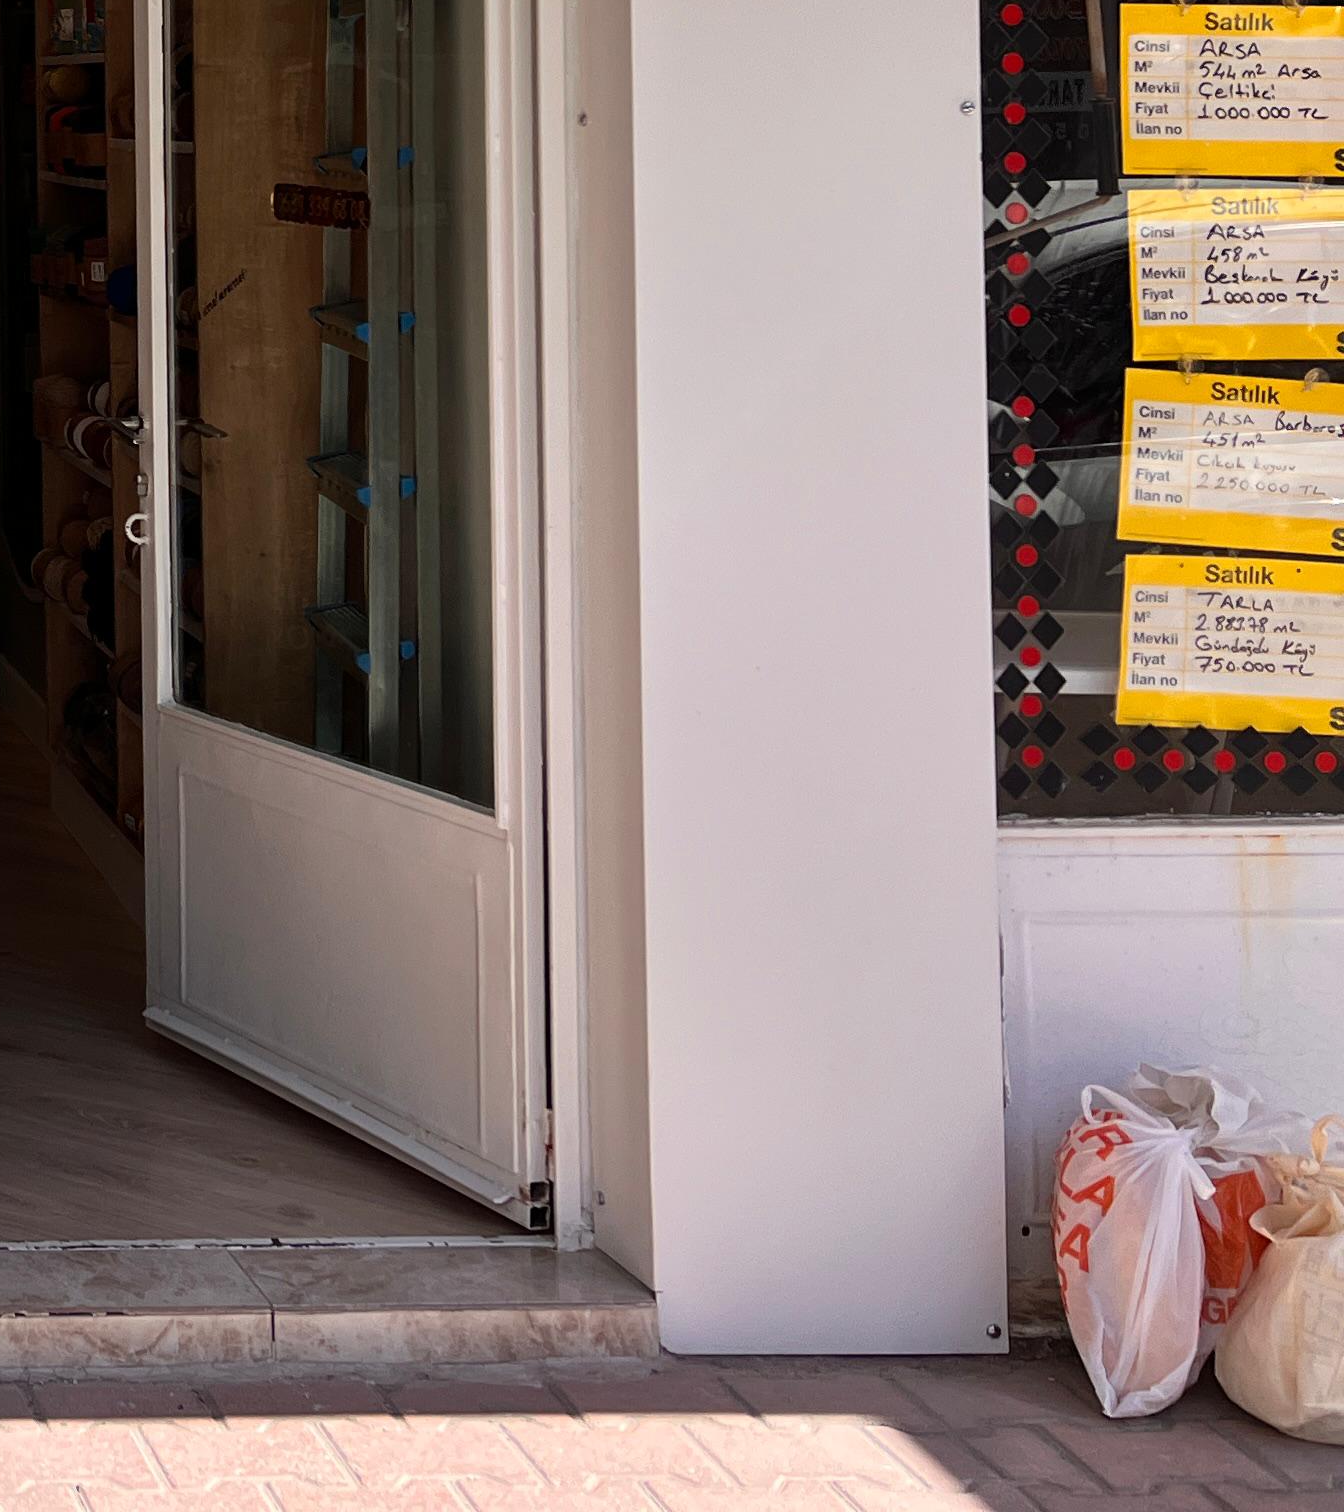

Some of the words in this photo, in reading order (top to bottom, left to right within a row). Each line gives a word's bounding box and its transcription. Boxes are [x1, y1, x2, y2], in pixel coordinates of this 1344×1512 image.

[1204, 12, 1274, 31] Satılık
[1135, 41, 1170, 52] Cinsi
[1199, 39, 1261, 59] ARSA
[1199, 61, 1236, 79] 544
[1135, 82, 1180, 93] Mevkii
[1135, 102, 1168, 116] Fiyat
[1298, 108, 1329, 119] TL
[1136, 121, 1160, 134] İlan
[1165, 124, 1182, 135] no
[1212, 196, 1279, 215] Satılık
[1141, 226, 1175, 238] Cinsi
[1207, 223, 1265, 240] ARSA
[1207, 247, 1243, 262] 458
[1142, 267, 1186, 279] Mevkii
[1142, 288, 1173, 301] Fiyat
[1296, 293, 1329, 303] TL
[1170, 310, 1188, 320] no
[1211, 382, 1280, 404] Satılık
[1139, 406, 1175, 420] Cinsi
[1203, 411, 1254, 426] ARSA
[1137, 447, 1183, 462] Mevkii
[1136, 468, 1170, 483] Fiyat
[1165, 492, 1183, 503] no
[1299, 485, 1325, 496] TL
[1204, 564, 1274, 585] Satılık
[1135, 590, 1168, 603] Cinsi
[1197, 592, 1274, 611] TARLA
[1133, 632, 1178, 645] Mevkii
[1133, 653, 1165, 667] Fiyat
[1283, 665, 1314, 676] TL
[1131, 674, 1156, 686] İlan
[1160, 676, 1178, 686] no
